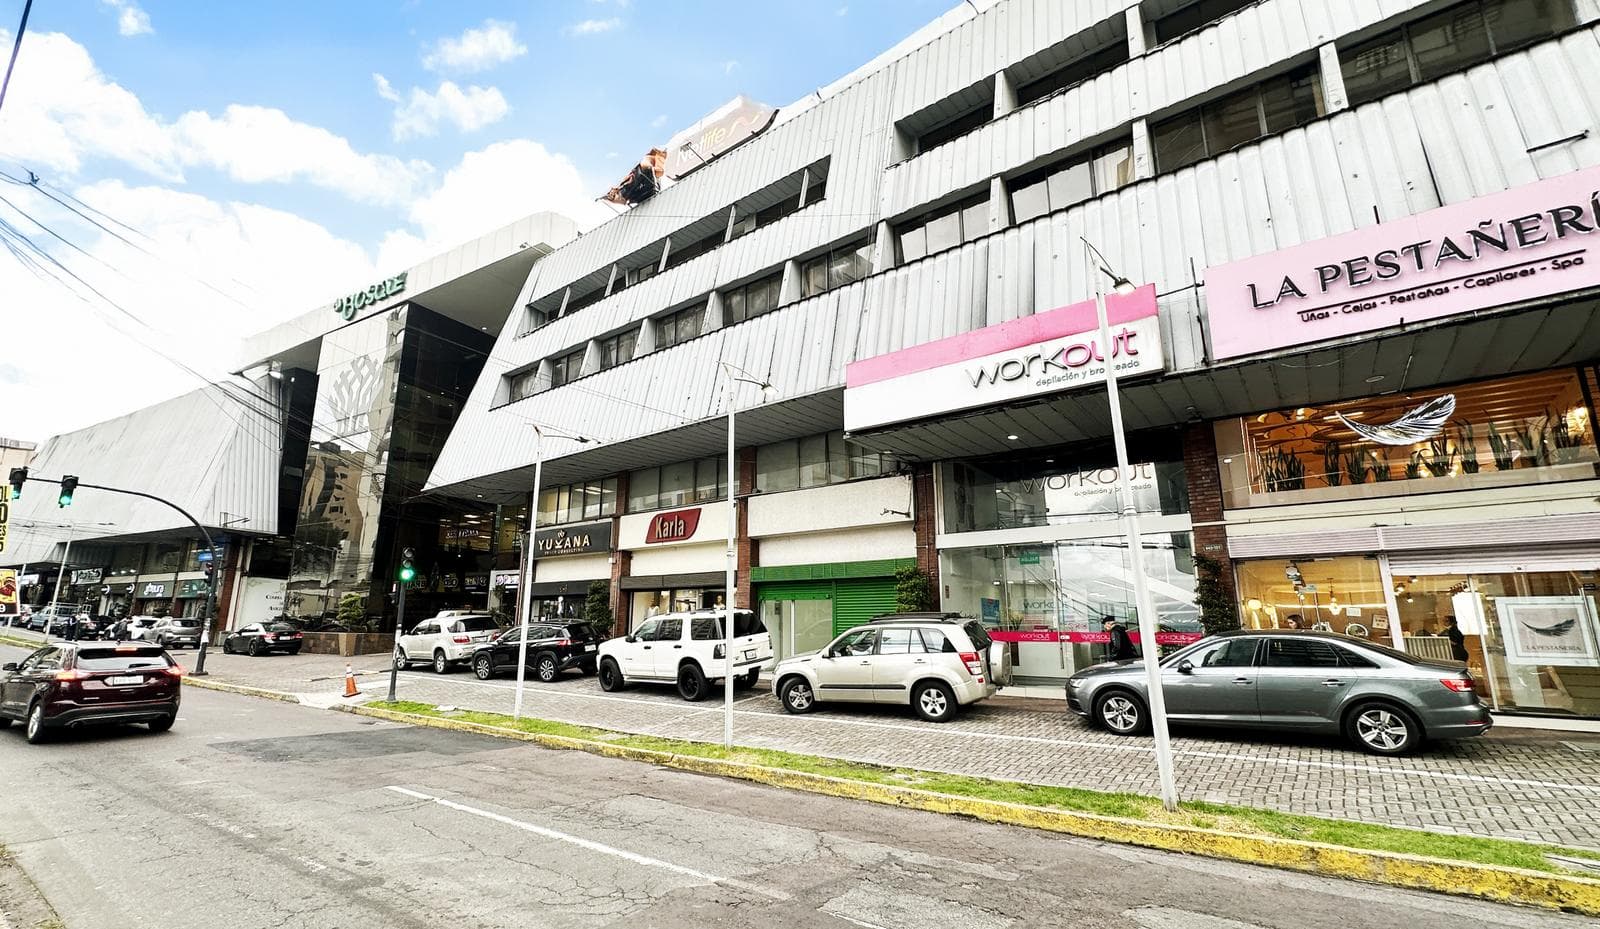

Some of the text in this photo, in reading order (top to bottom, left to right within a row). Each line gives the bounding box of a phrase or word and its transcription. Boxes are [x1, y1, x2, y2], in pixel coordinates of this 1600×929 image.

[1247, 275, 1306, 309] LA
[1301, 255, 1584, 323] Uñas Cejas Pestañas Capilares Spa
[965, 327, 1138, 388] workout
[1036, 359, 1140, 387] depilación y broeado
[538, 534, 590, 550] YUKANA
[655, 519, 685, 539] Karla
